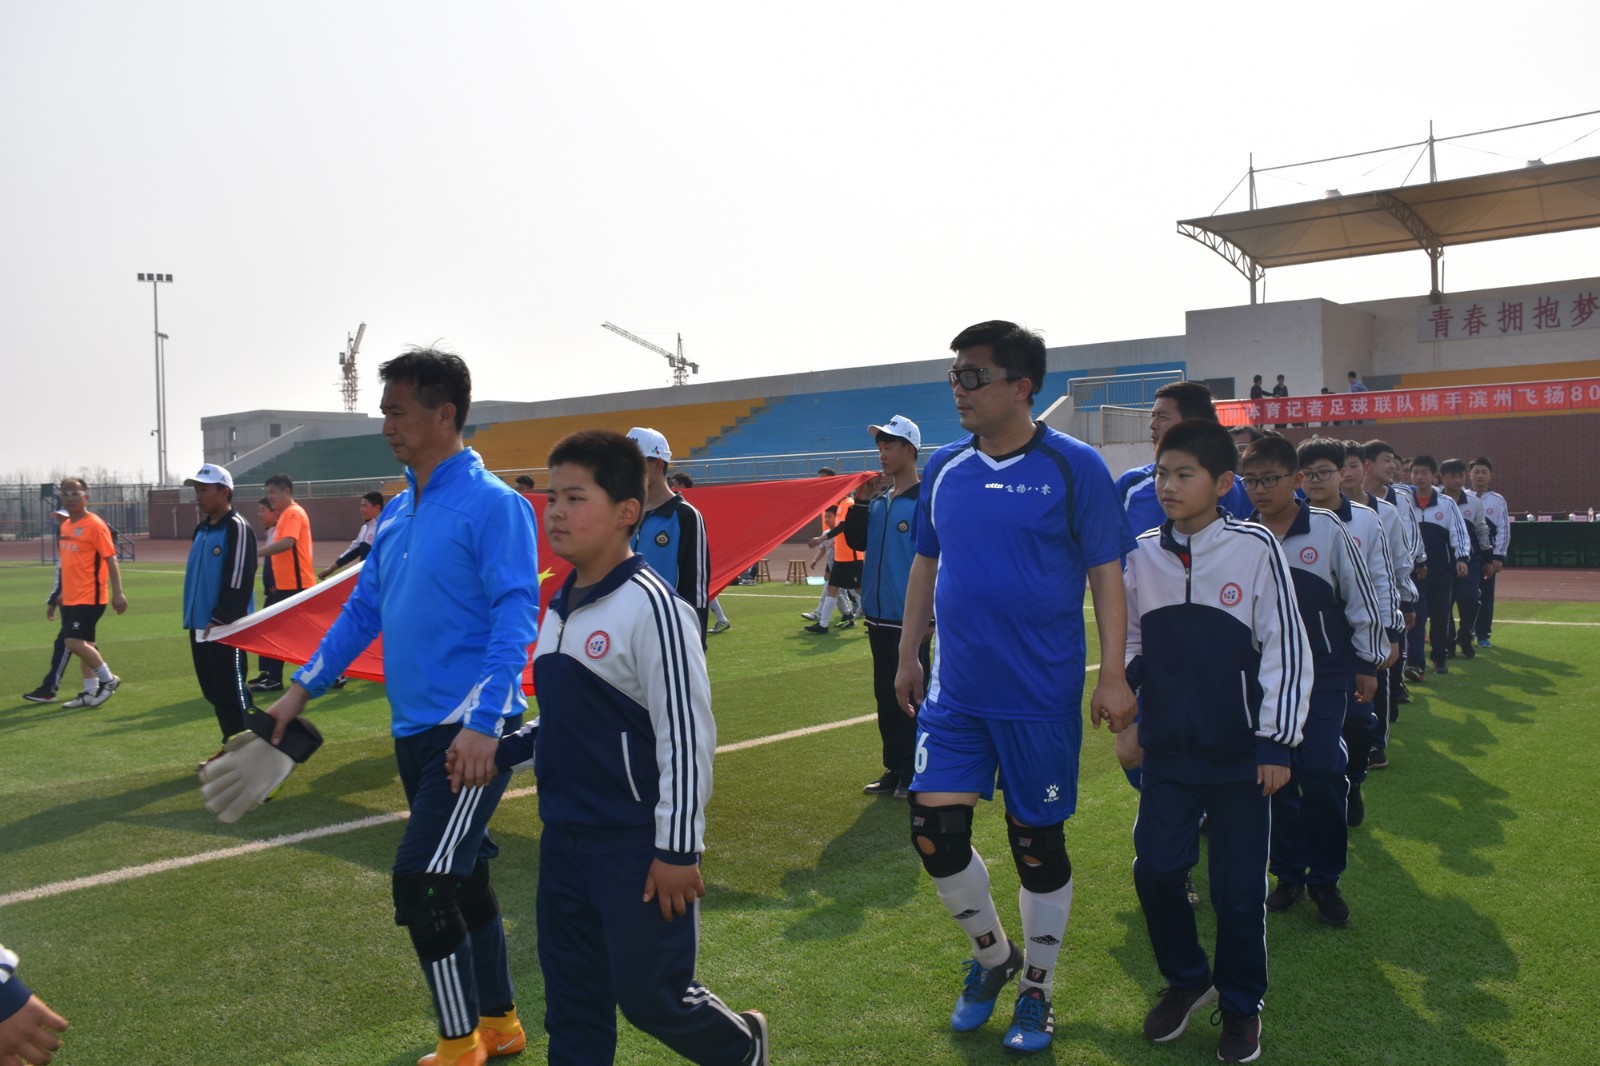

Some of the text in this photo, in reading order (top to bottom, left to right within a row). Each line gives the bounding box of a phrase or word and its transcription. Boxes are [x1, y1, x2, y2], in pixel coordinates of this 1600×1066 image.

[1428, 292, 1600, 338] 青春拥抱梦
[914, 731, 930, 774] 6
